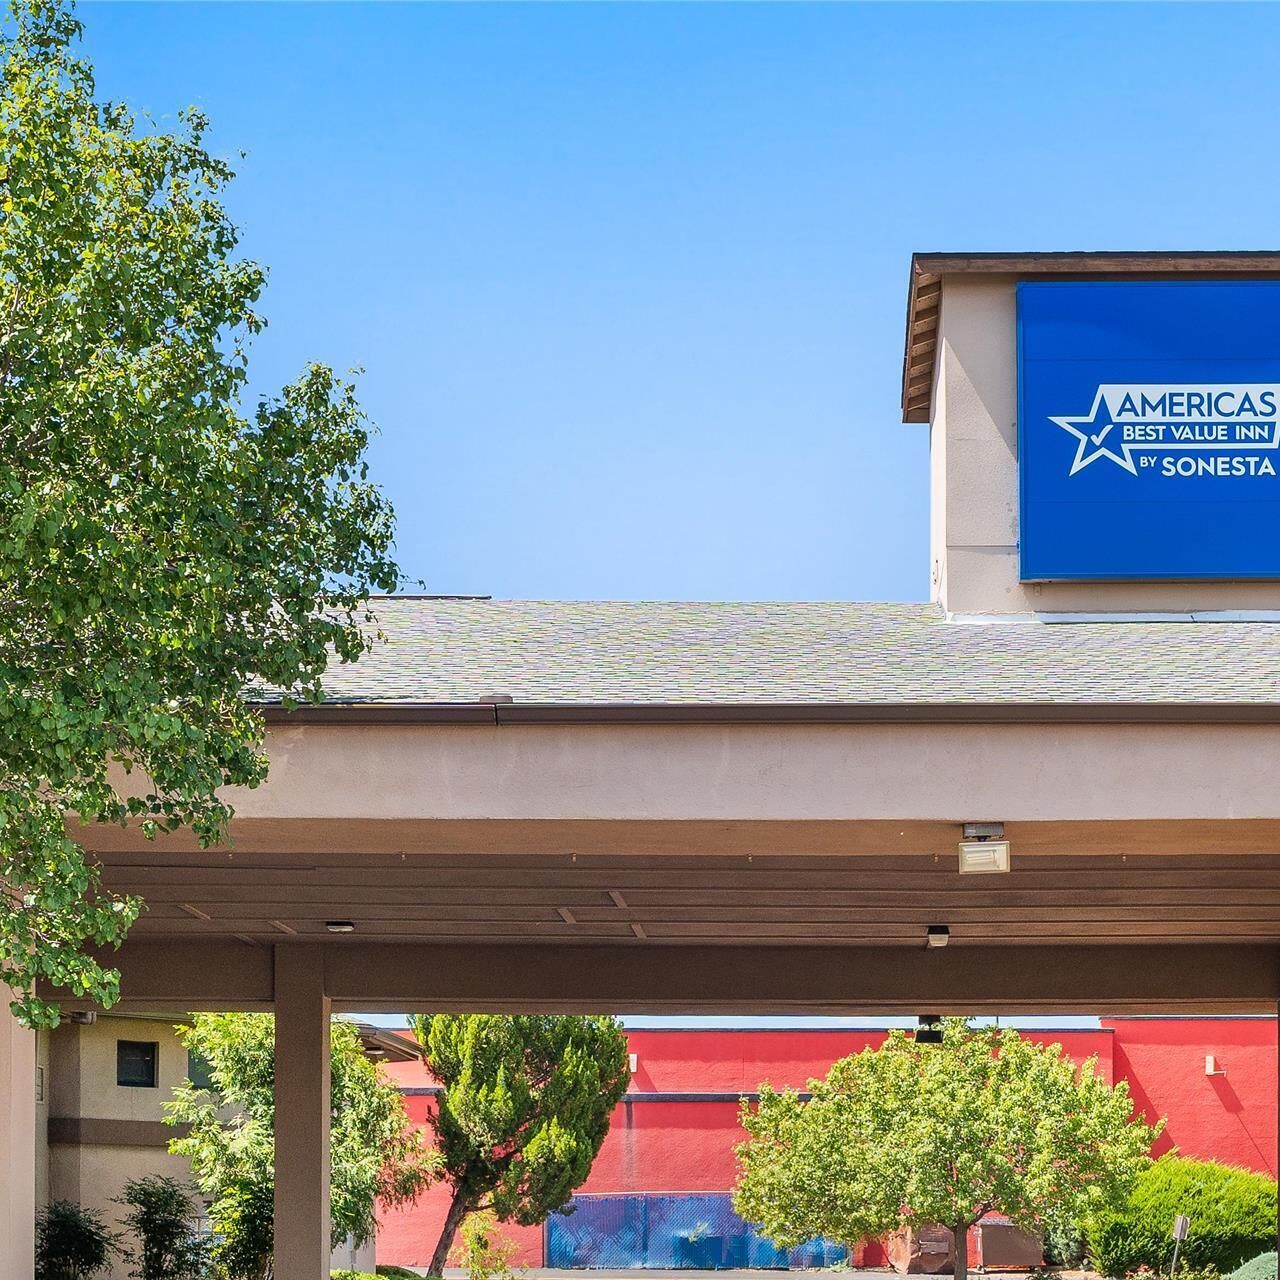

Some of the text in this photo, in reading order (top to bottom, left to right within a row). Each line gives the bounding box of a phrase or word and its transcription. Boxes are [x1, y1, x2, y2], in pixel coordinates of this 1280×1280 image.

[1117, 392, 1276, 417] AMERICAS
[1124, 426, 1268, 440] BEST VALUE INN
[1141, 457, 1275, 476] BY SONESTA
